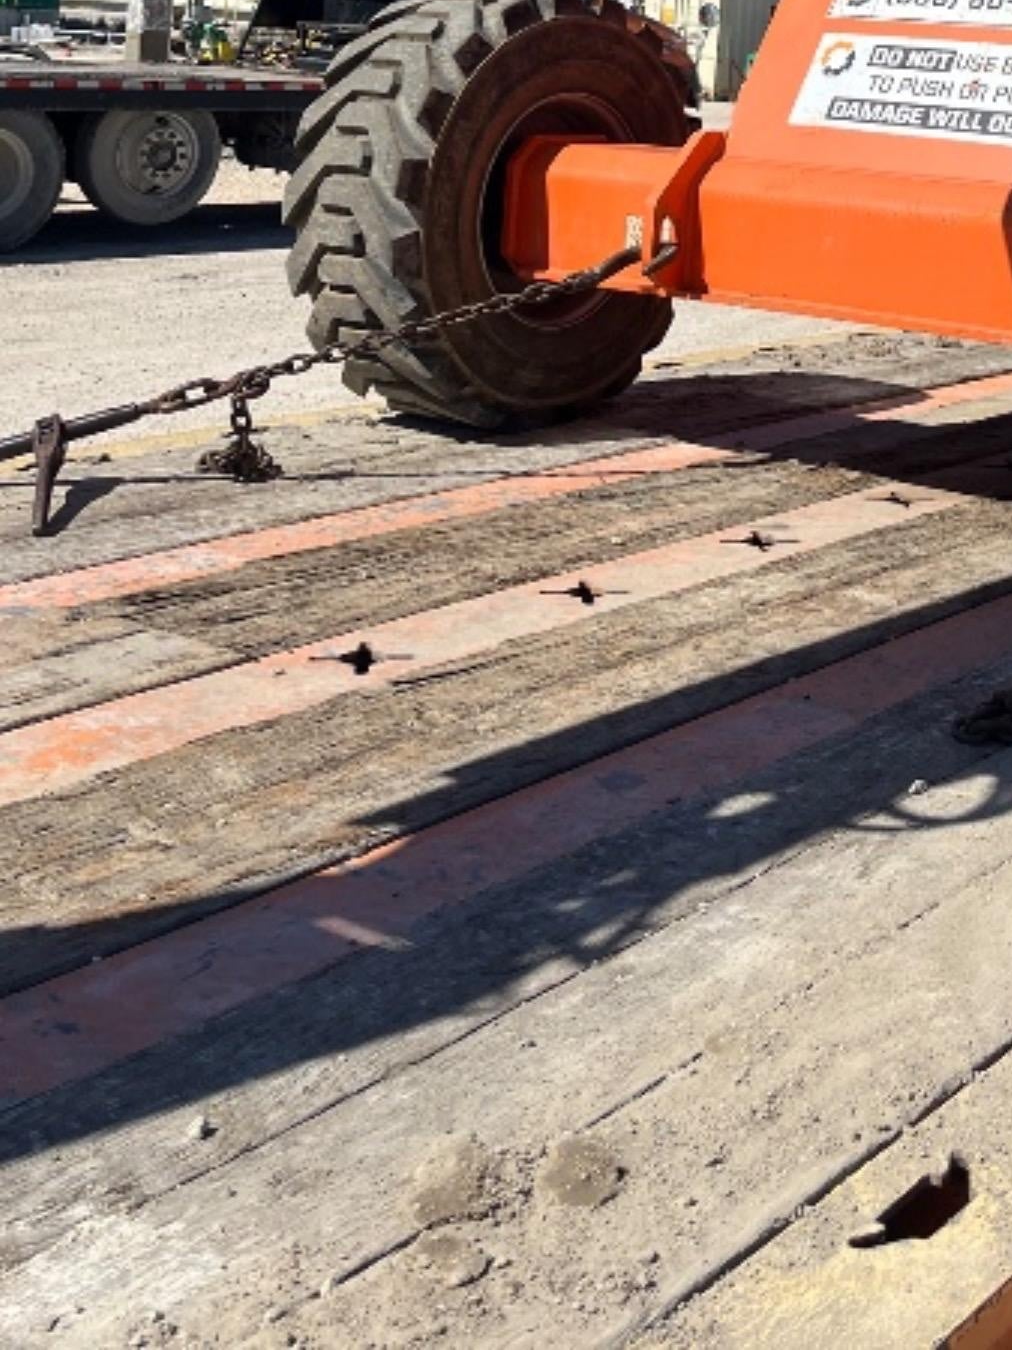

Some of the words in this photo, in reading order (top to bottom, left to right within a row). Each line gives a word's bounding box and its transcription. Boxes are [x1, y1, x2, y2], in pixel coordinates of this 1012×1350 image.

[869, 46, 898, 67] DO
[904, 48, 954, 71] NOT
[956, 52, 998, 74] USE
[869, 74, 896, 94] TO
[897, 76, 954, 99] PUSH
[959, 80, 989, 103] OR
[830, 99, 924, 125] DAMAGE
[927, 107, 984, 132] WILL
